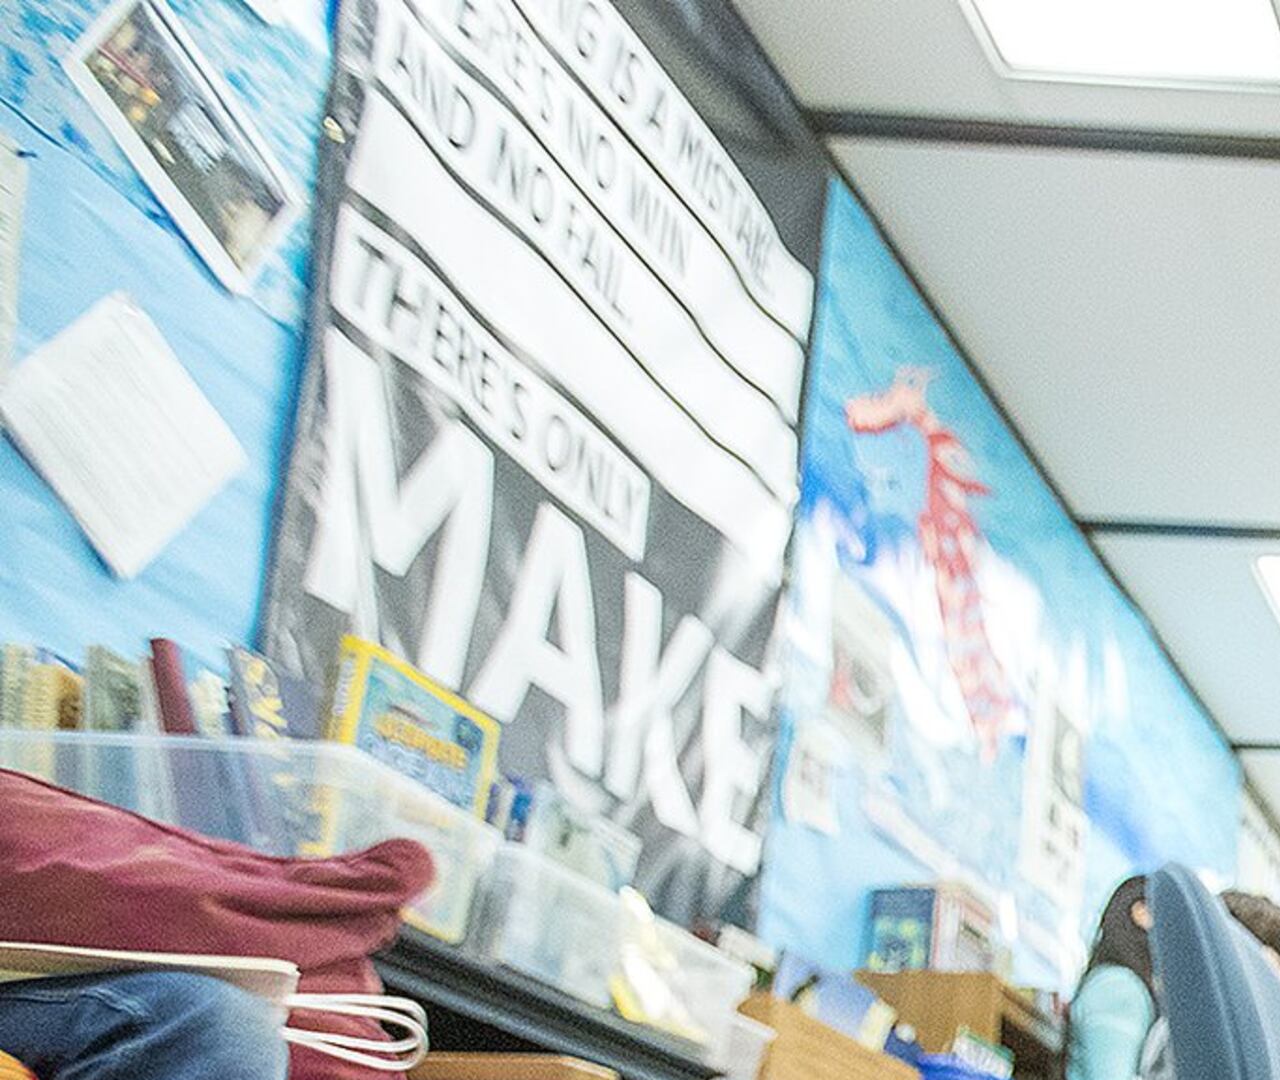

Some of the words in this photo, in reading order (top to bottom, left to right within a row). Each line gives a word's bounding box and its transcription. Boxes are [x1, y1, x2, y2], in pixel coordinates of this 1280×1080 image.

[391, 22, 477, 153] AND
[491, 127, 553, 226] NO
[606, 35, 643, 104] IS
[567, 97, 616, 190] NO
[629, 166, 690, 279] WIN
[541, 413, 644, 534] ONLY
[303, 322, 779, 877] MAKE
